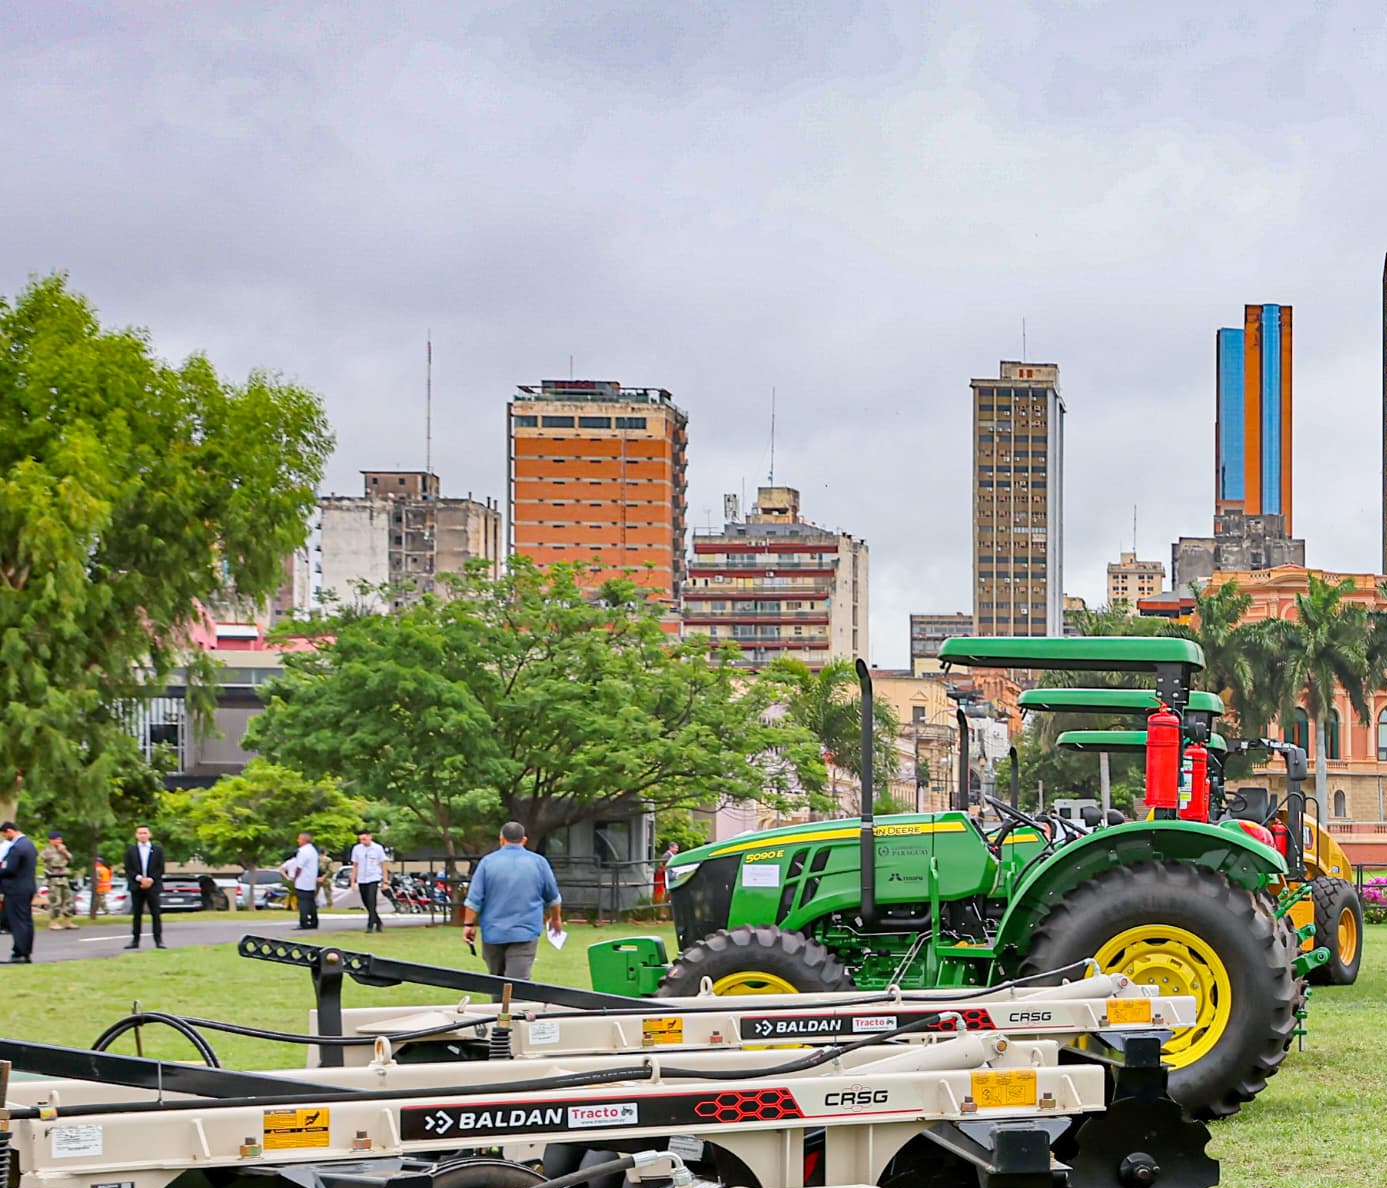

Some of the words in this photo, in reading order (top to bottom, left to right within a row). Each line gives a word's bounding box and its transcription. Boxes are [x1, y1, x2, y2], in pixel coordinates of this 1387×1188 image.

[887, 826, 921, 835] DEERE
[745, 851, 776, 863] 5090
[776, 850, 785, 858] E
[1009, 1011, 1052, 1022] CRSG
[776, 1019, 842, 1033] BALDAN
[855, 1019, 885, 1027] Tracto
[825, 1089, 889, 1107] CRSG
[459, 1108, 563, 1130] BALDAN
[571, 1107, 618, 1119] Tracto
